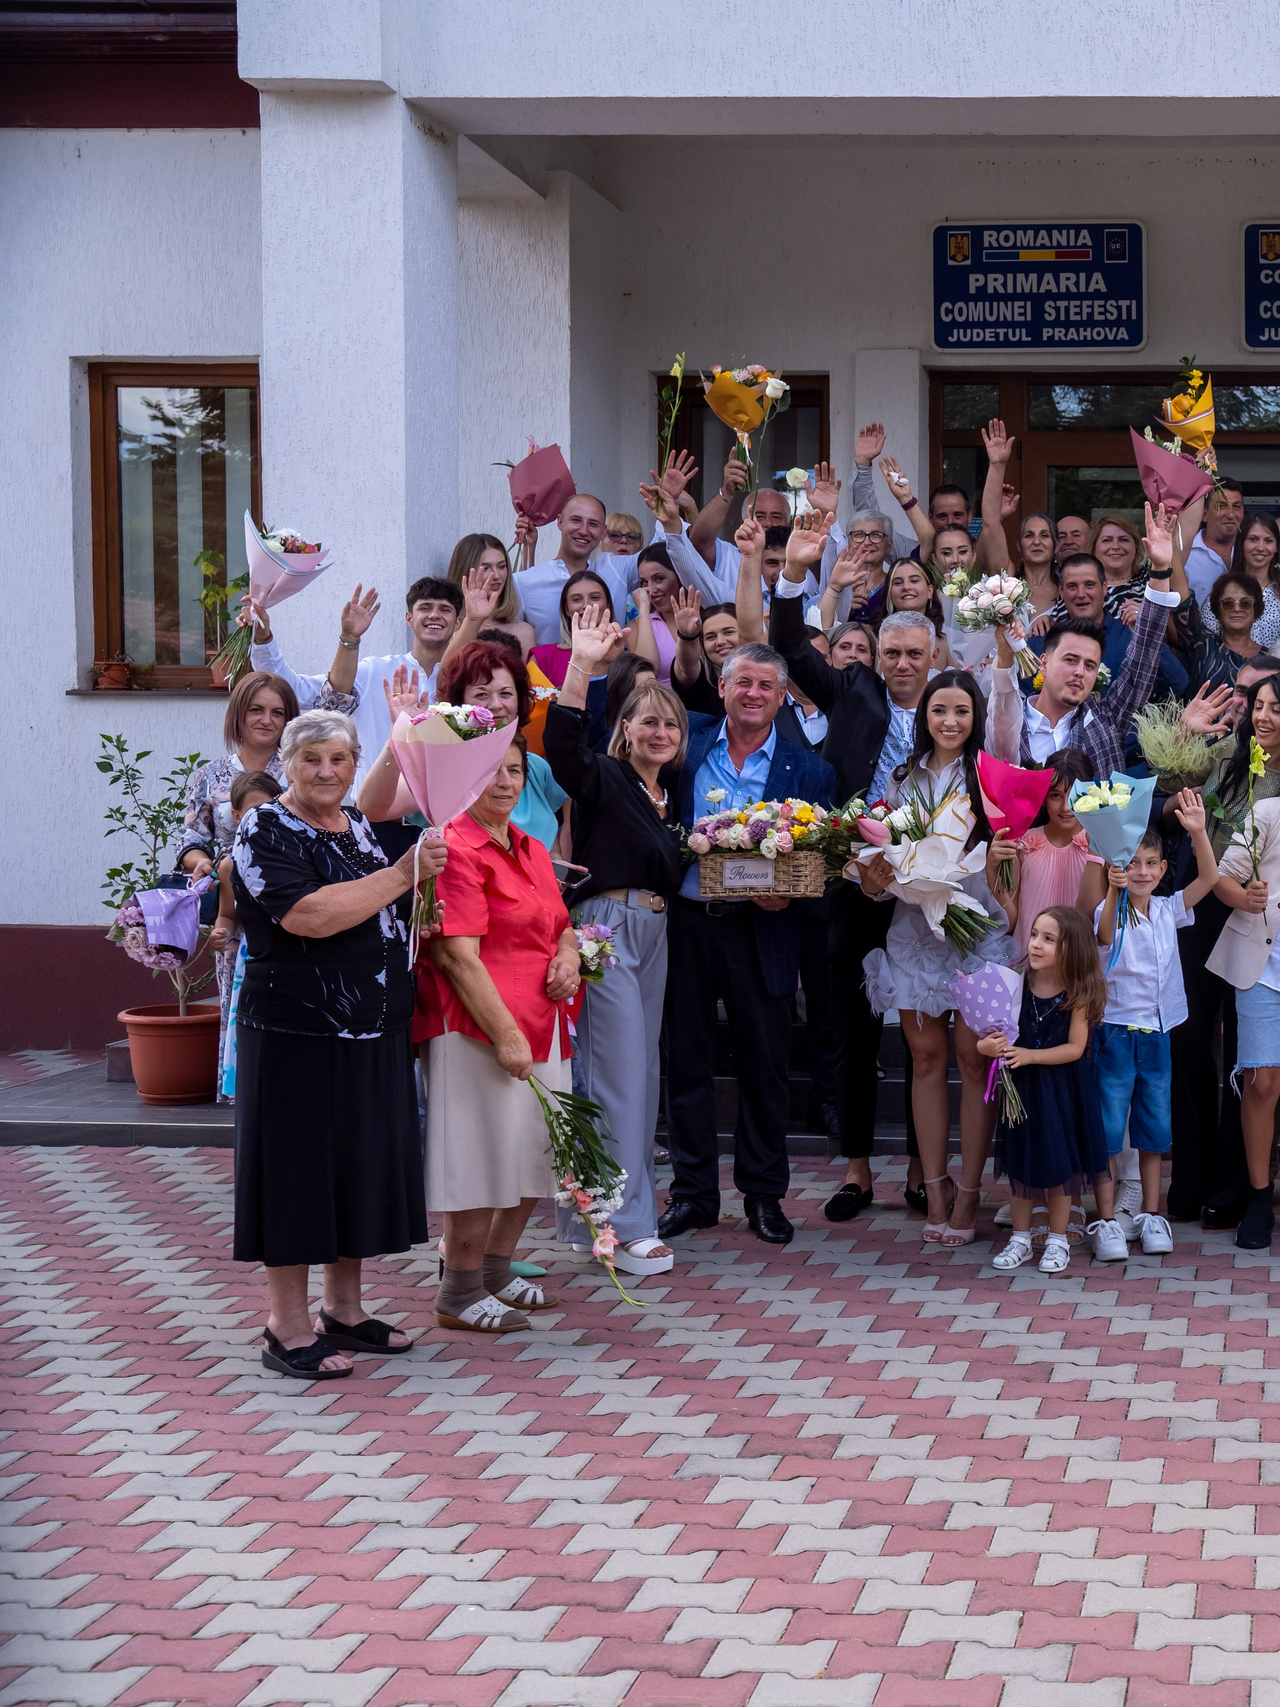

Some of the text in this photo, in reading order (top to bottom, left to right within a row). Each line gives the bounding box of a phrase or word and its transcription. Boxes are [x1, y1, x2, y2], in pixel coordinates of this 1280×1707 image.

[983, 229, 1093, 247] ROMANIA
[968, 272, 1108, 294] PRIMARIA
[940, 299, 1137, 322] COMUNEI STEFESTI
[948, 327, 1129, 342] JUDETUL PRAHOVA
[729, 865, 769, 880] Flowers
